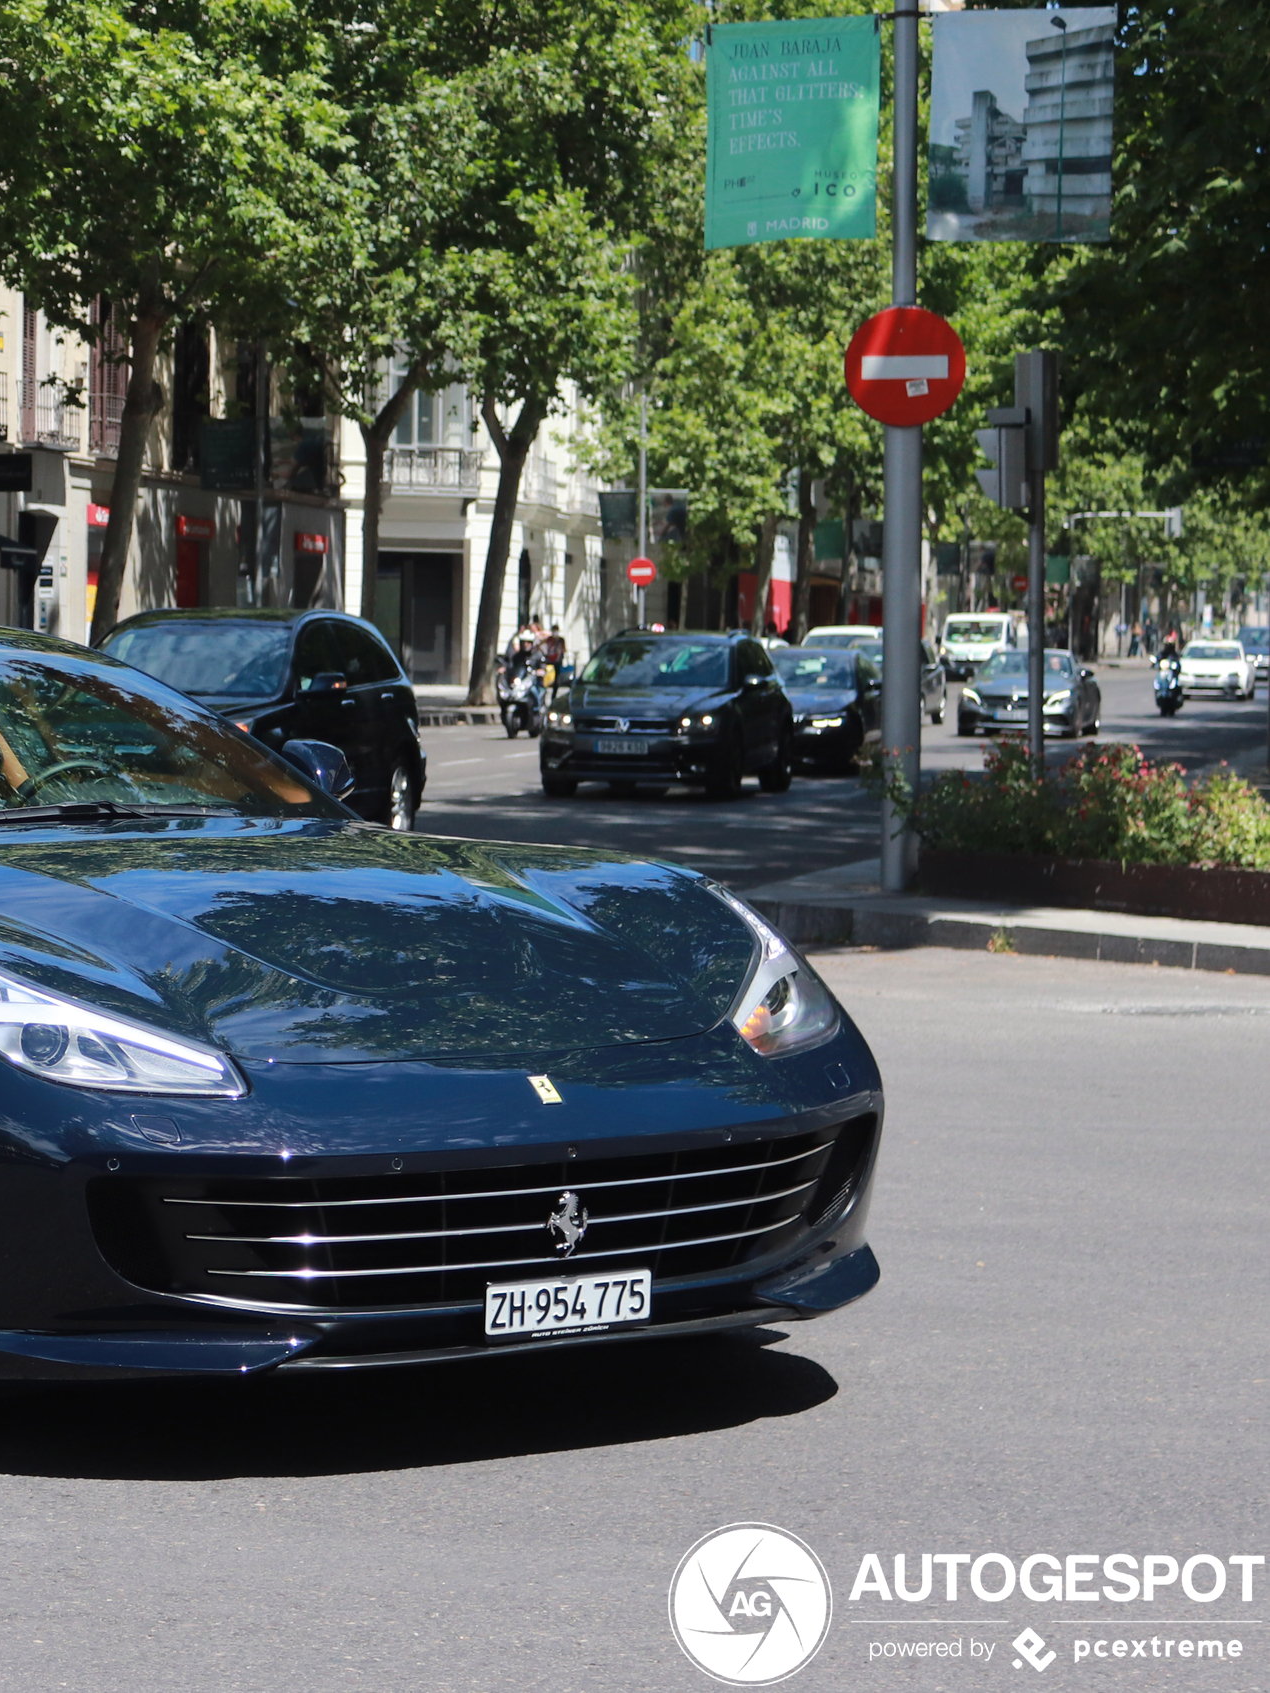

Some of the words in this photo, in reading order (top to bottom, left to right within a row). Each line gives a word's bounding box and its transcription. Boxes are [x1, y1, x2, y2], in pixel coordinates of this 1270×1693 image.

[729, 42, 770, 60] JUAN
[781, 37, 842, 56] BARAJA
[728, 62, 801, 83] AGAINST
[807, 60, 838, 78] ALL
[728, 86, 769, 106] THAT
[728, 109, 782, 130] TIME'S
[729, 131, 801, 155] EFFECTS.
[814, 171, 857, 180] MUSEO
[814, 182, 856, 197] ICO
[765, 217, 829, 232] MADRID
[594, 1278, 645, 1319] 775
